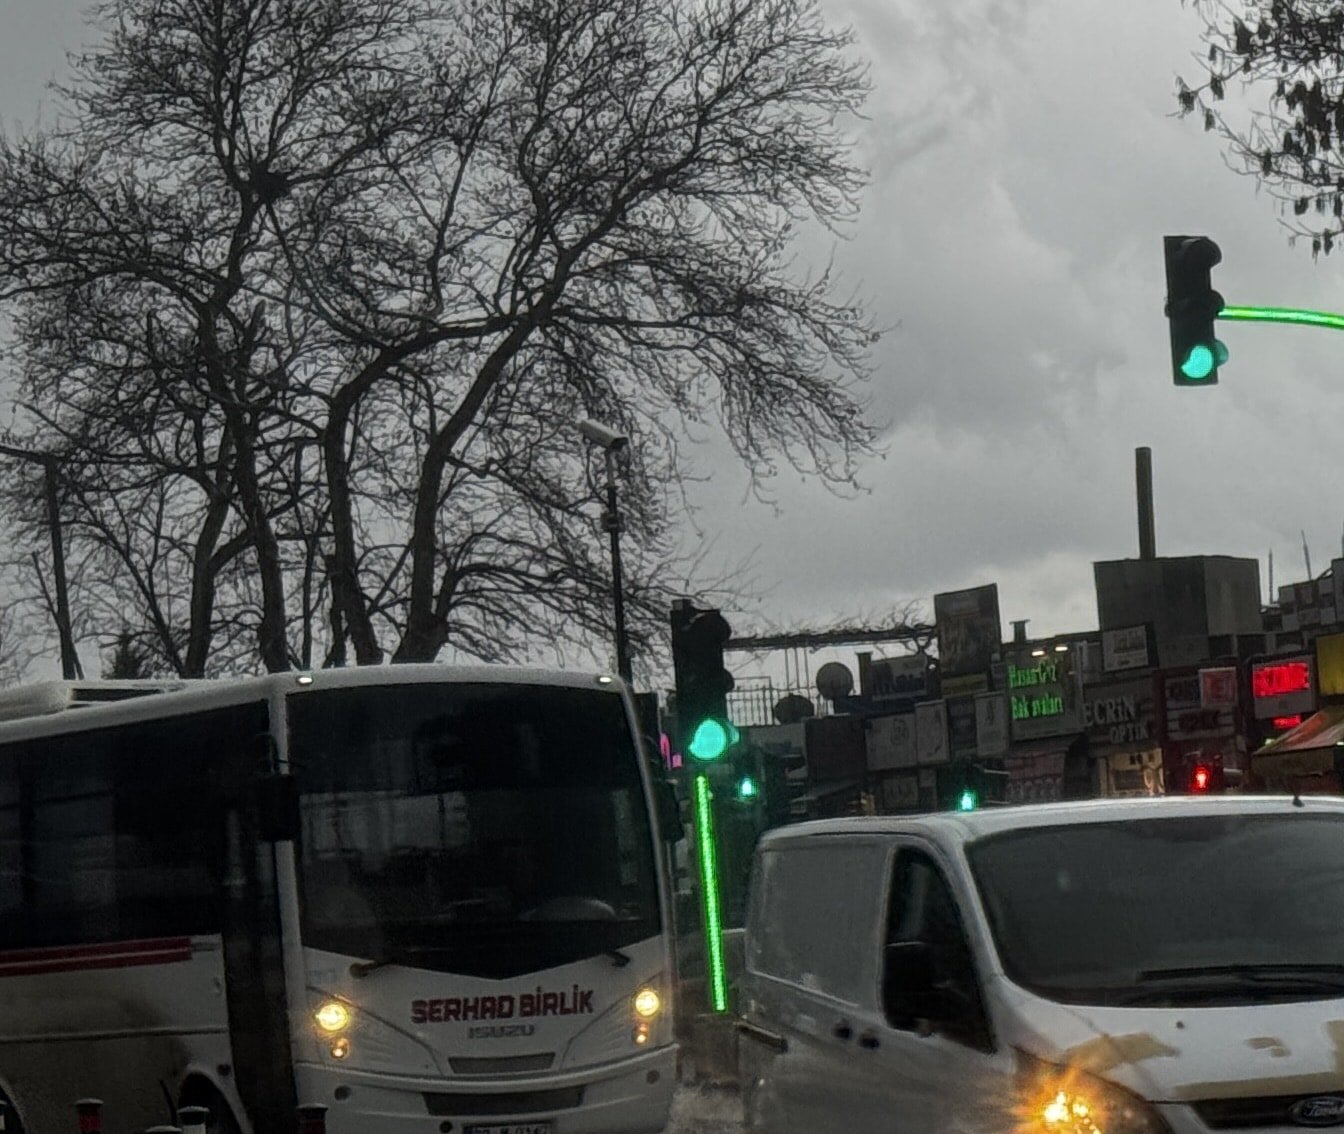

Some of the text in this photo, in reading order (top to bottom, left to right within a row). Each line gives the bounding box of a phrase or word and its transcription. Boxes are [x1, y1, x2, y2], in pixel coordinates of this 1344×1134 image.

[411, 984, 595, 1024] SERHAD BİRLİK
[468, 1024, 536, 1039] ISUZU
